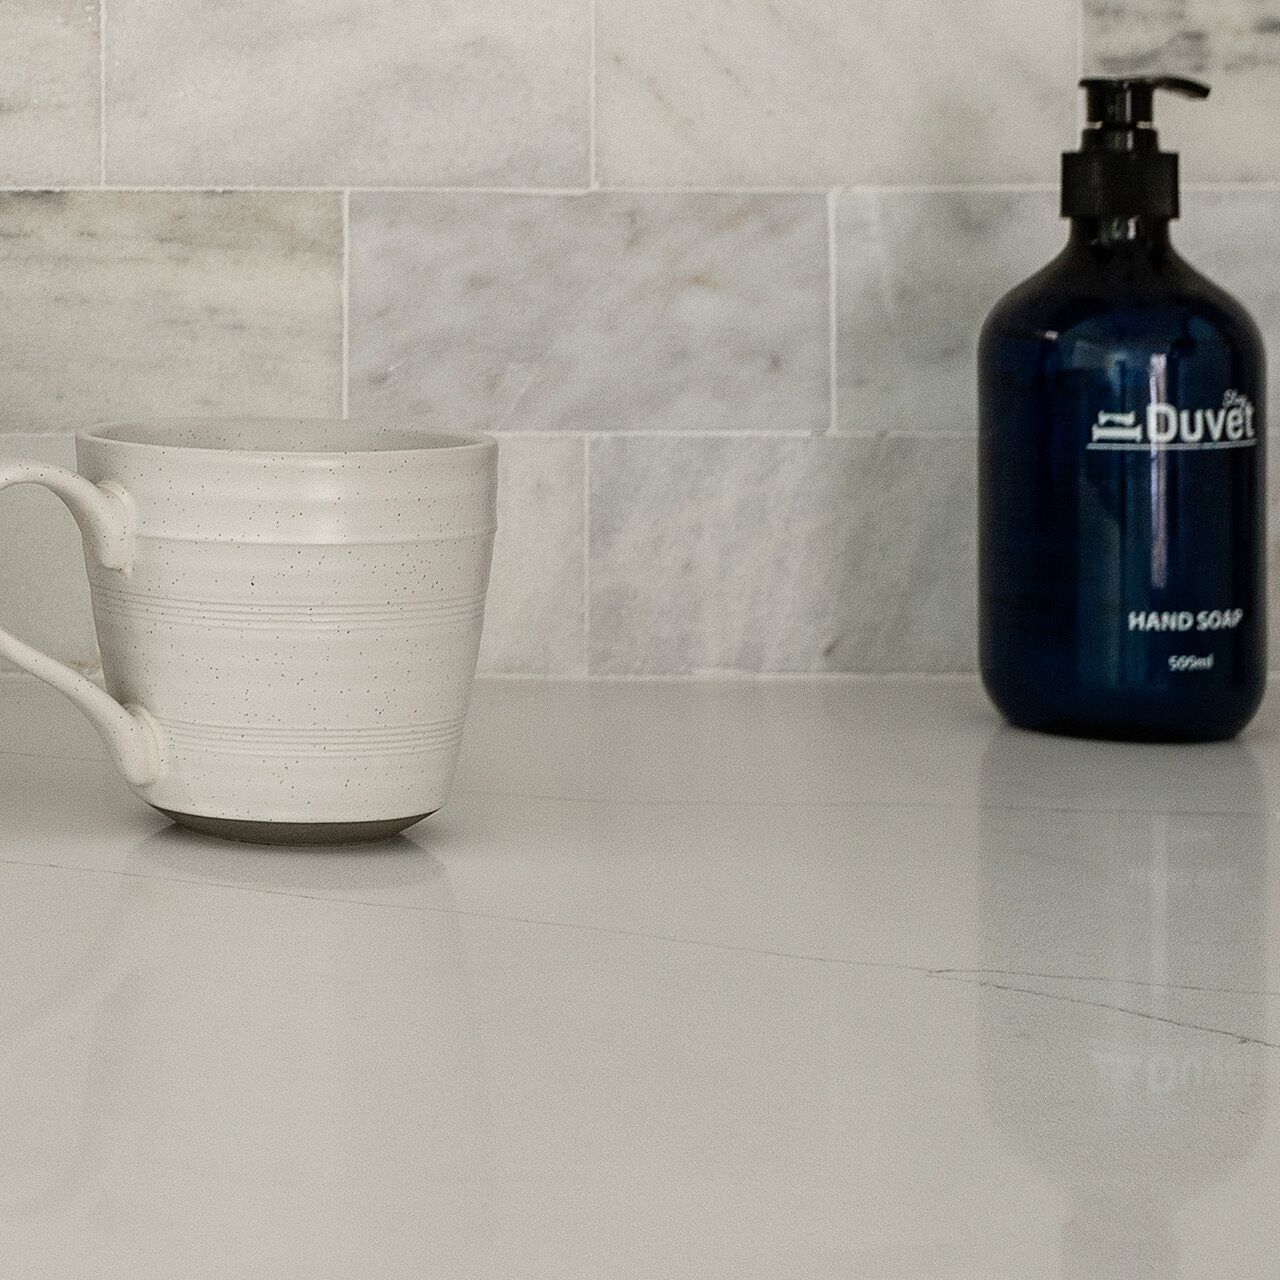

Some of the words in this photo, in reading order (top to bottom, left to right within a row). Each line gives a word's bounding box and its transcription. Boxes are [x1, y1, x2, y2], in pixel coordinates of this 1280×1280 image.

[1146, 402, 1256, 443] Duvet
[1128, 611, 1193, 631] HAND
[1196, 609, 1244, 630] SOAP
